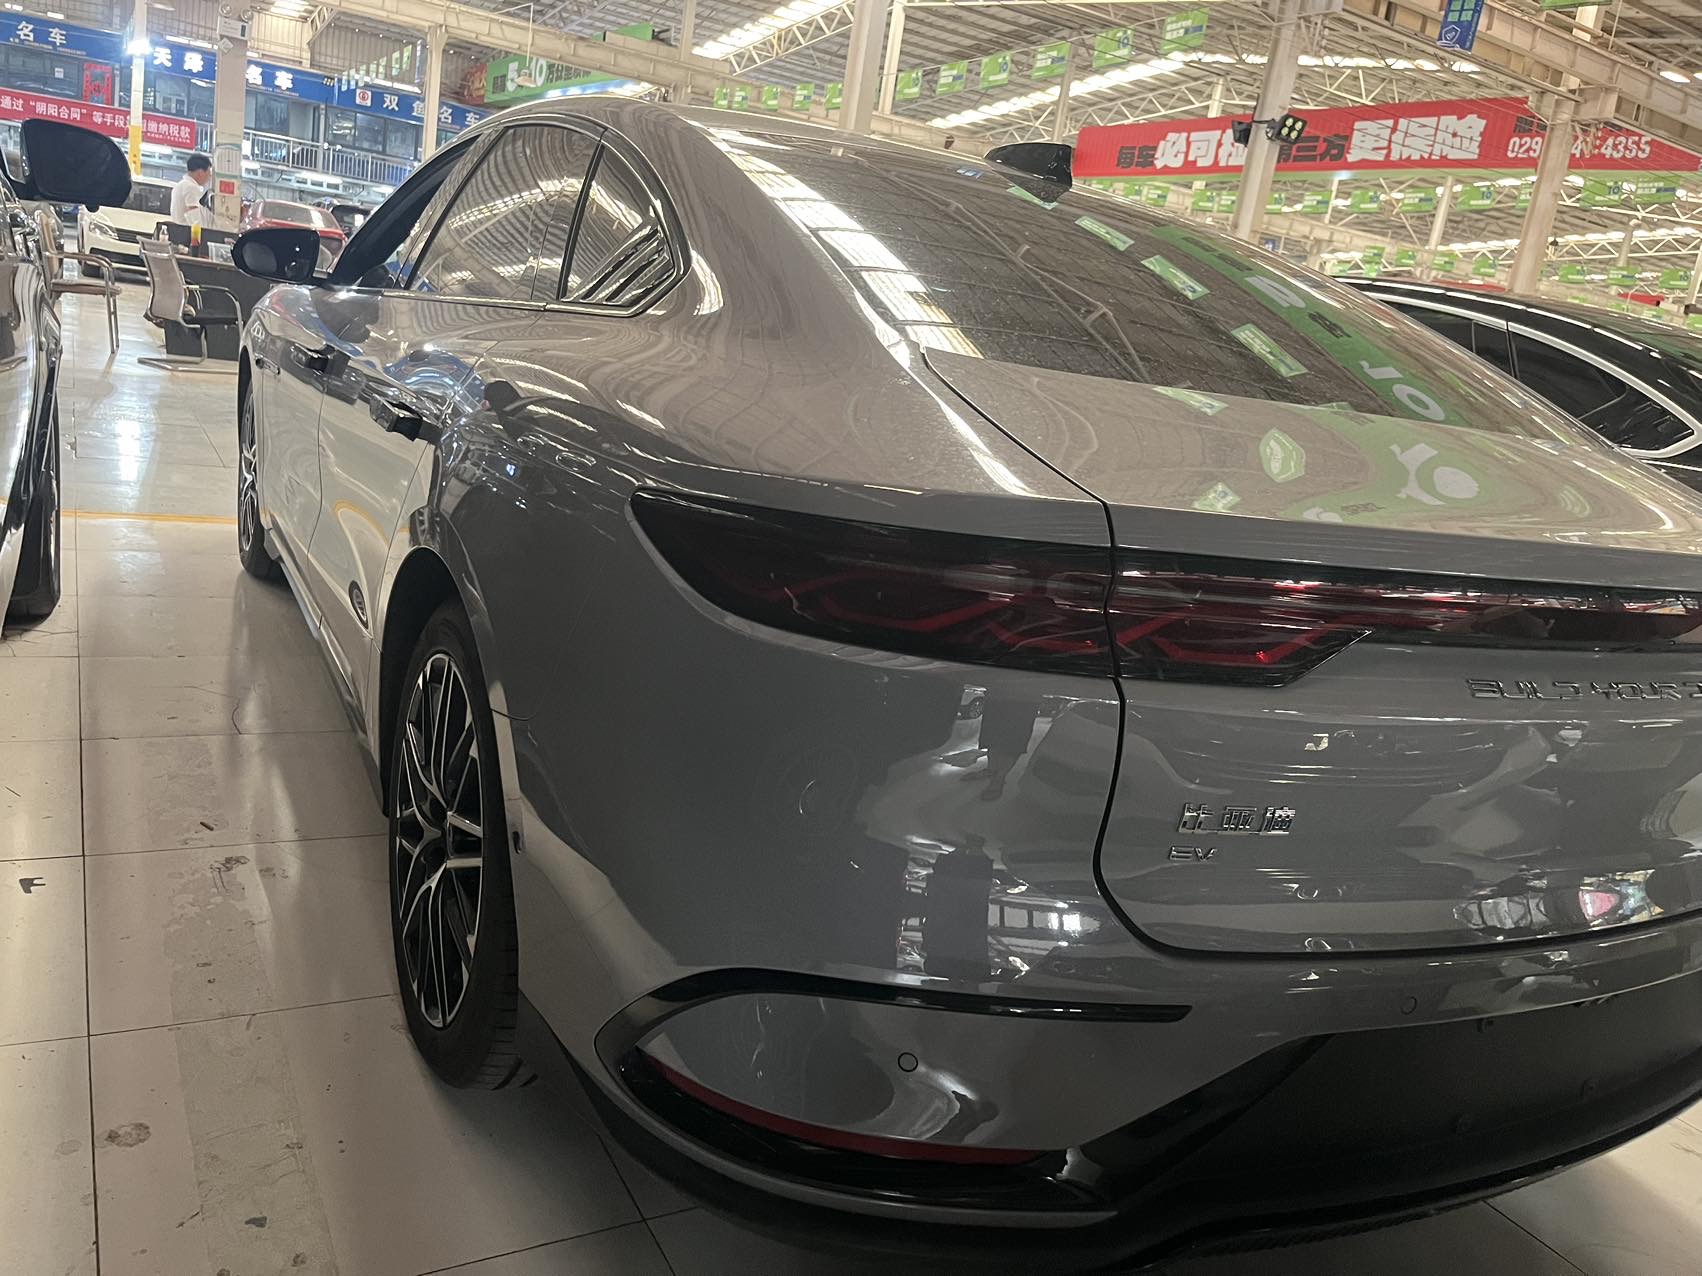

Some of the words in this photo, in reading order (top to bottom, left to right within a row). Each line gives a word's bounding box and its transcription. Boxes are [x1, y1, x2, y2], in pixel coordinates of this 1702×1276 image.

[16, 21, 67, 46] 名车
[1467, 679, 1583, 699] BUILD
[1179, 803, 1296, 835] 比亚迪
[1169, 845, 1217, 861] EV
